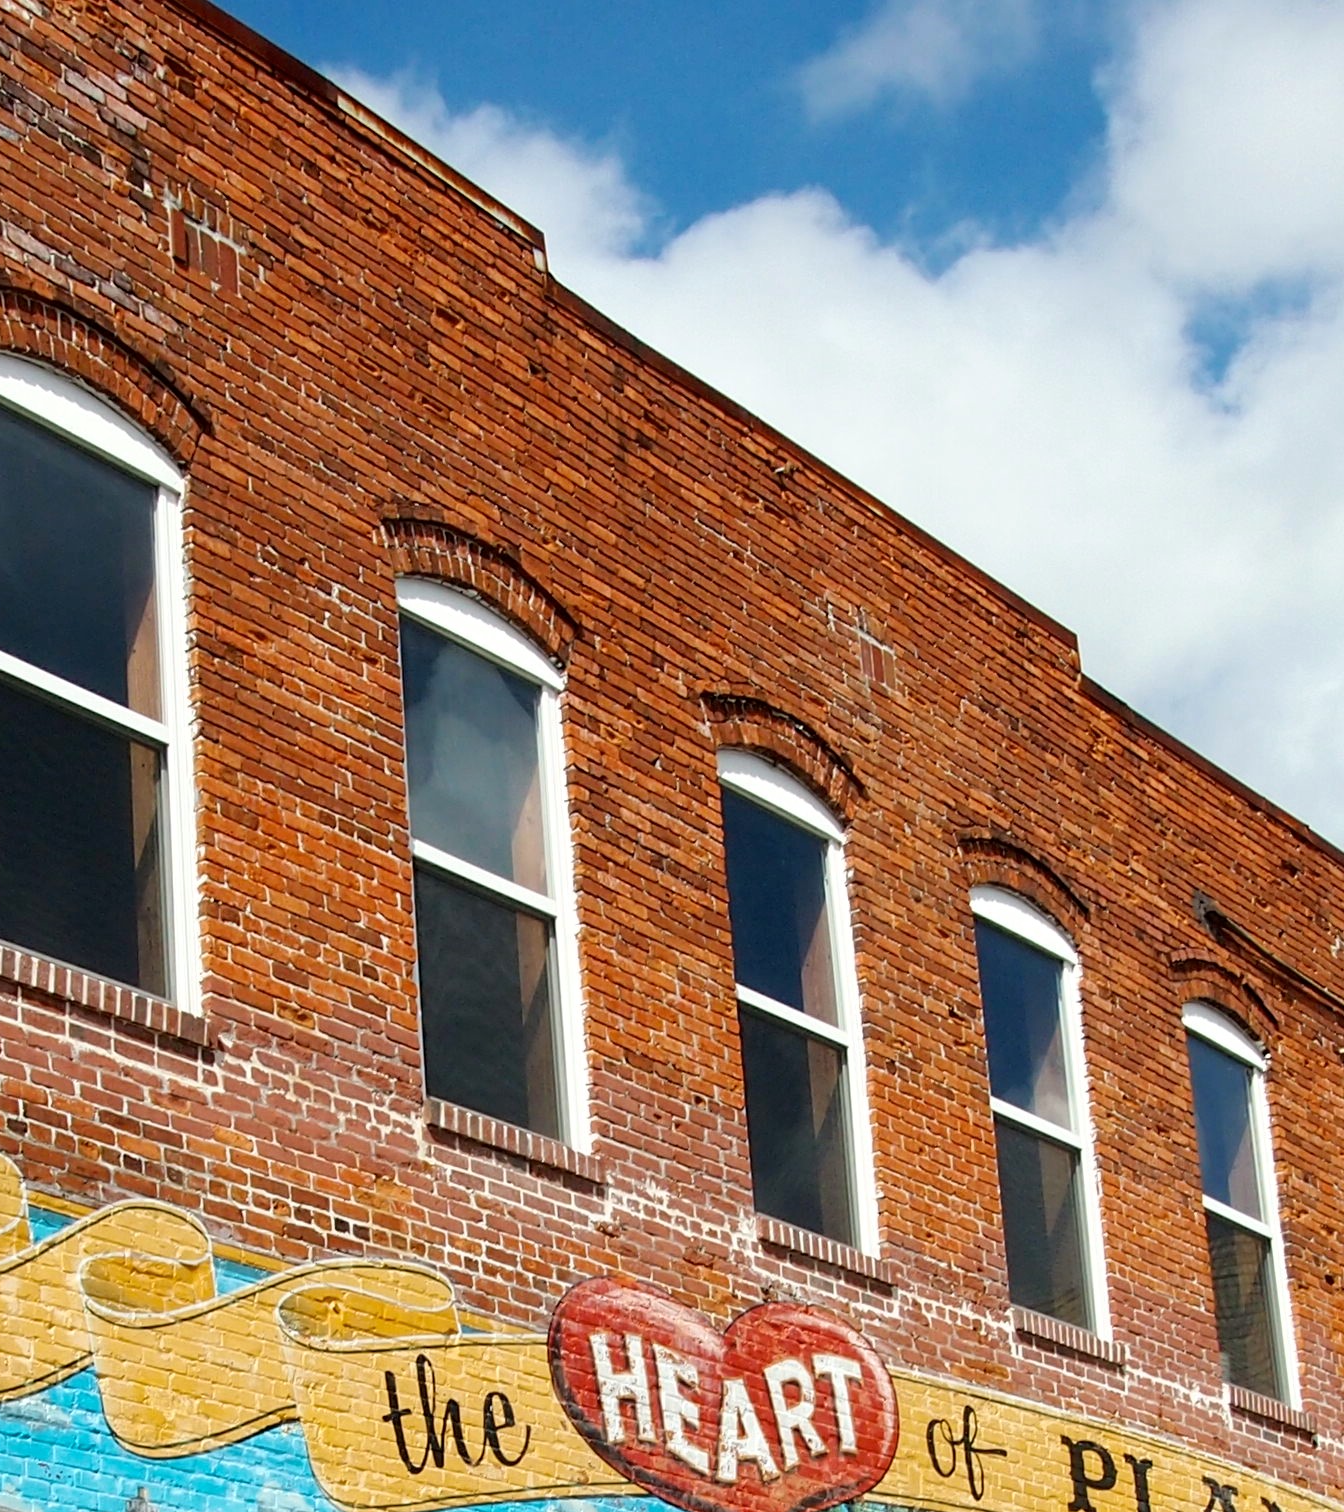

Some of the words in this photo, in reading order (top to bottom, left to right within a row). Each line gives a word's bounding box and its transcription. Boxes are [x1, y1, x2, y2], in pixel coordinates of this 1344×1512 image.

[383, 1354, 531, 1475] the
[589, 1331, 862, 1484] HEART
[925, 1405, 1006, 1501] of
